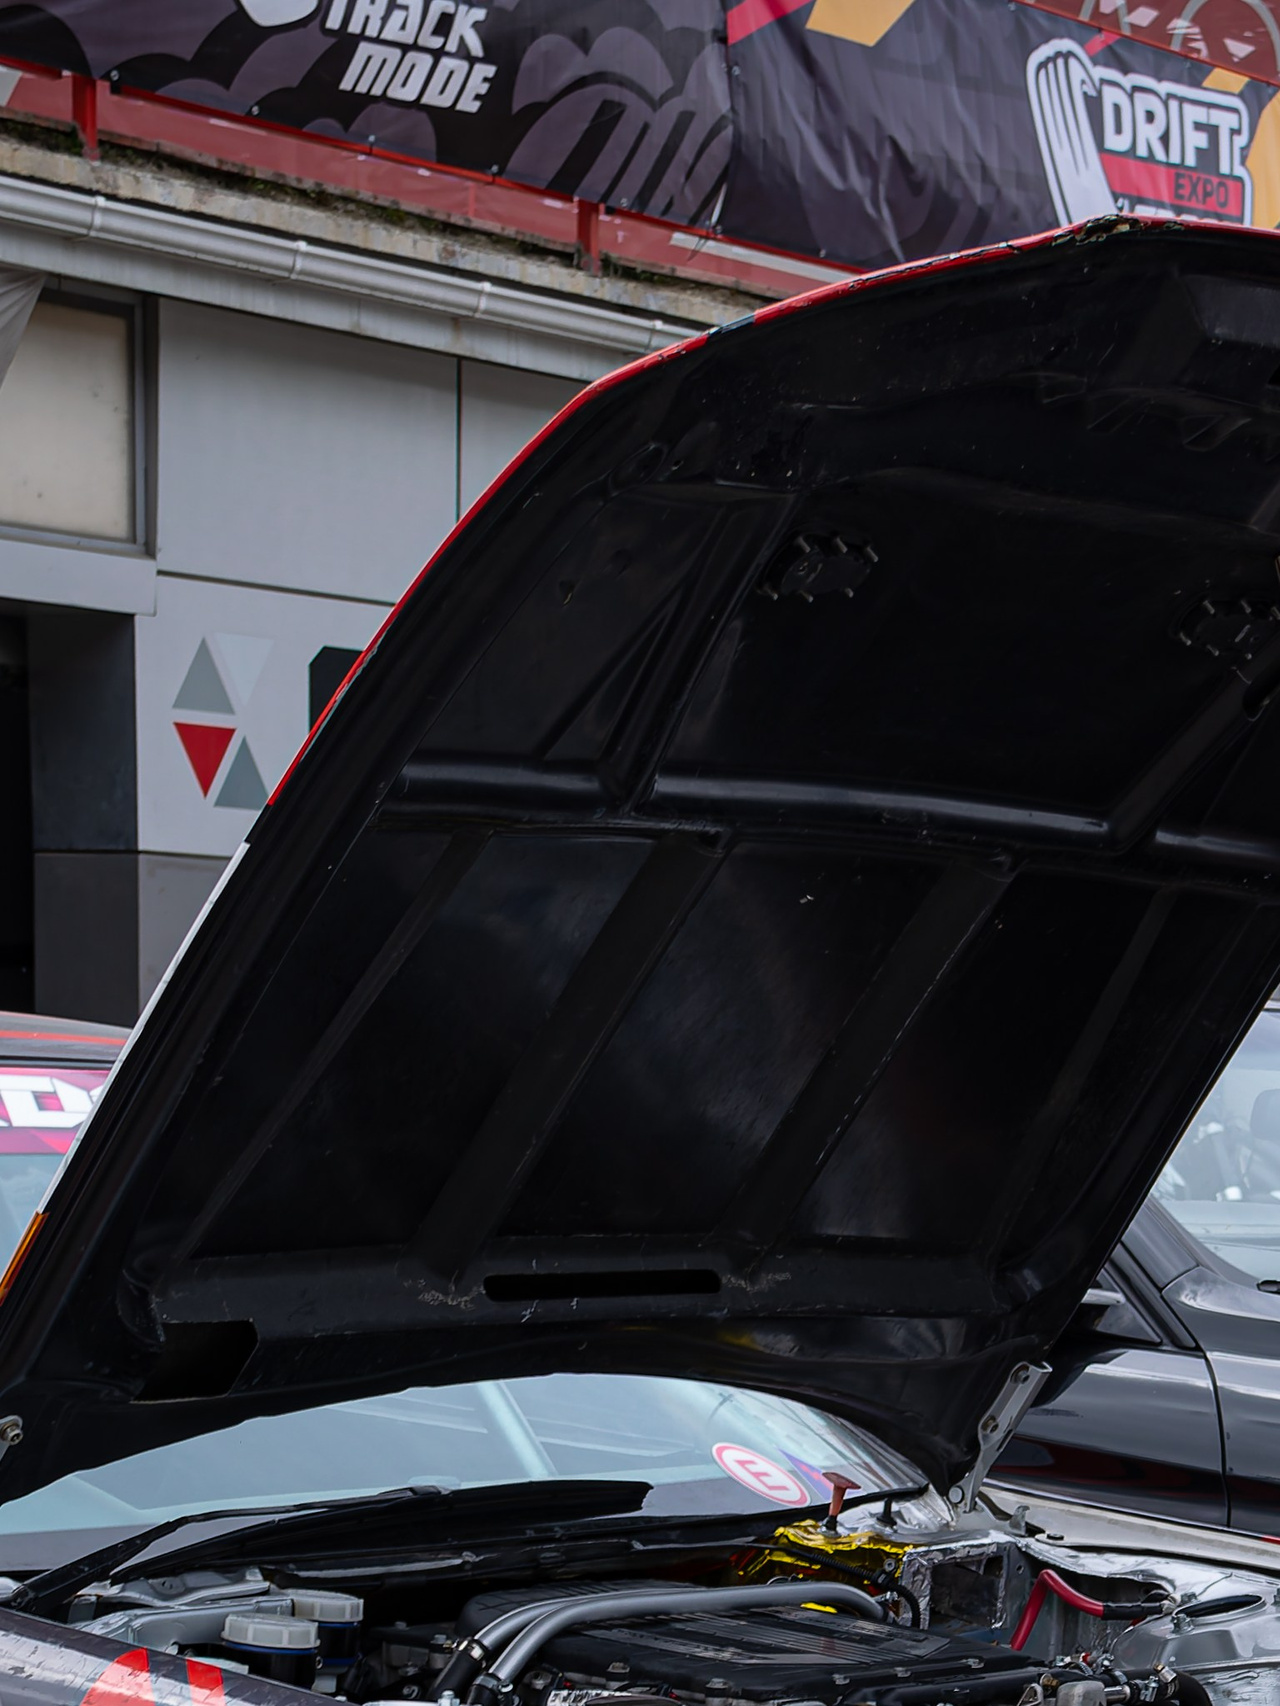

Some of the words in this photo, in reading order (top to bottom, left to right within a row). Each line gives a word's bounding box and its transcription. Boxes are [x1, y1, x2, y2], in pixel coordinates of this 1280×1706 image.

[338, 41, 498, 114] MODE
[1101, 83, 1240, 176] DRIFT
[1173, 174, 1229, 209] EXPO
